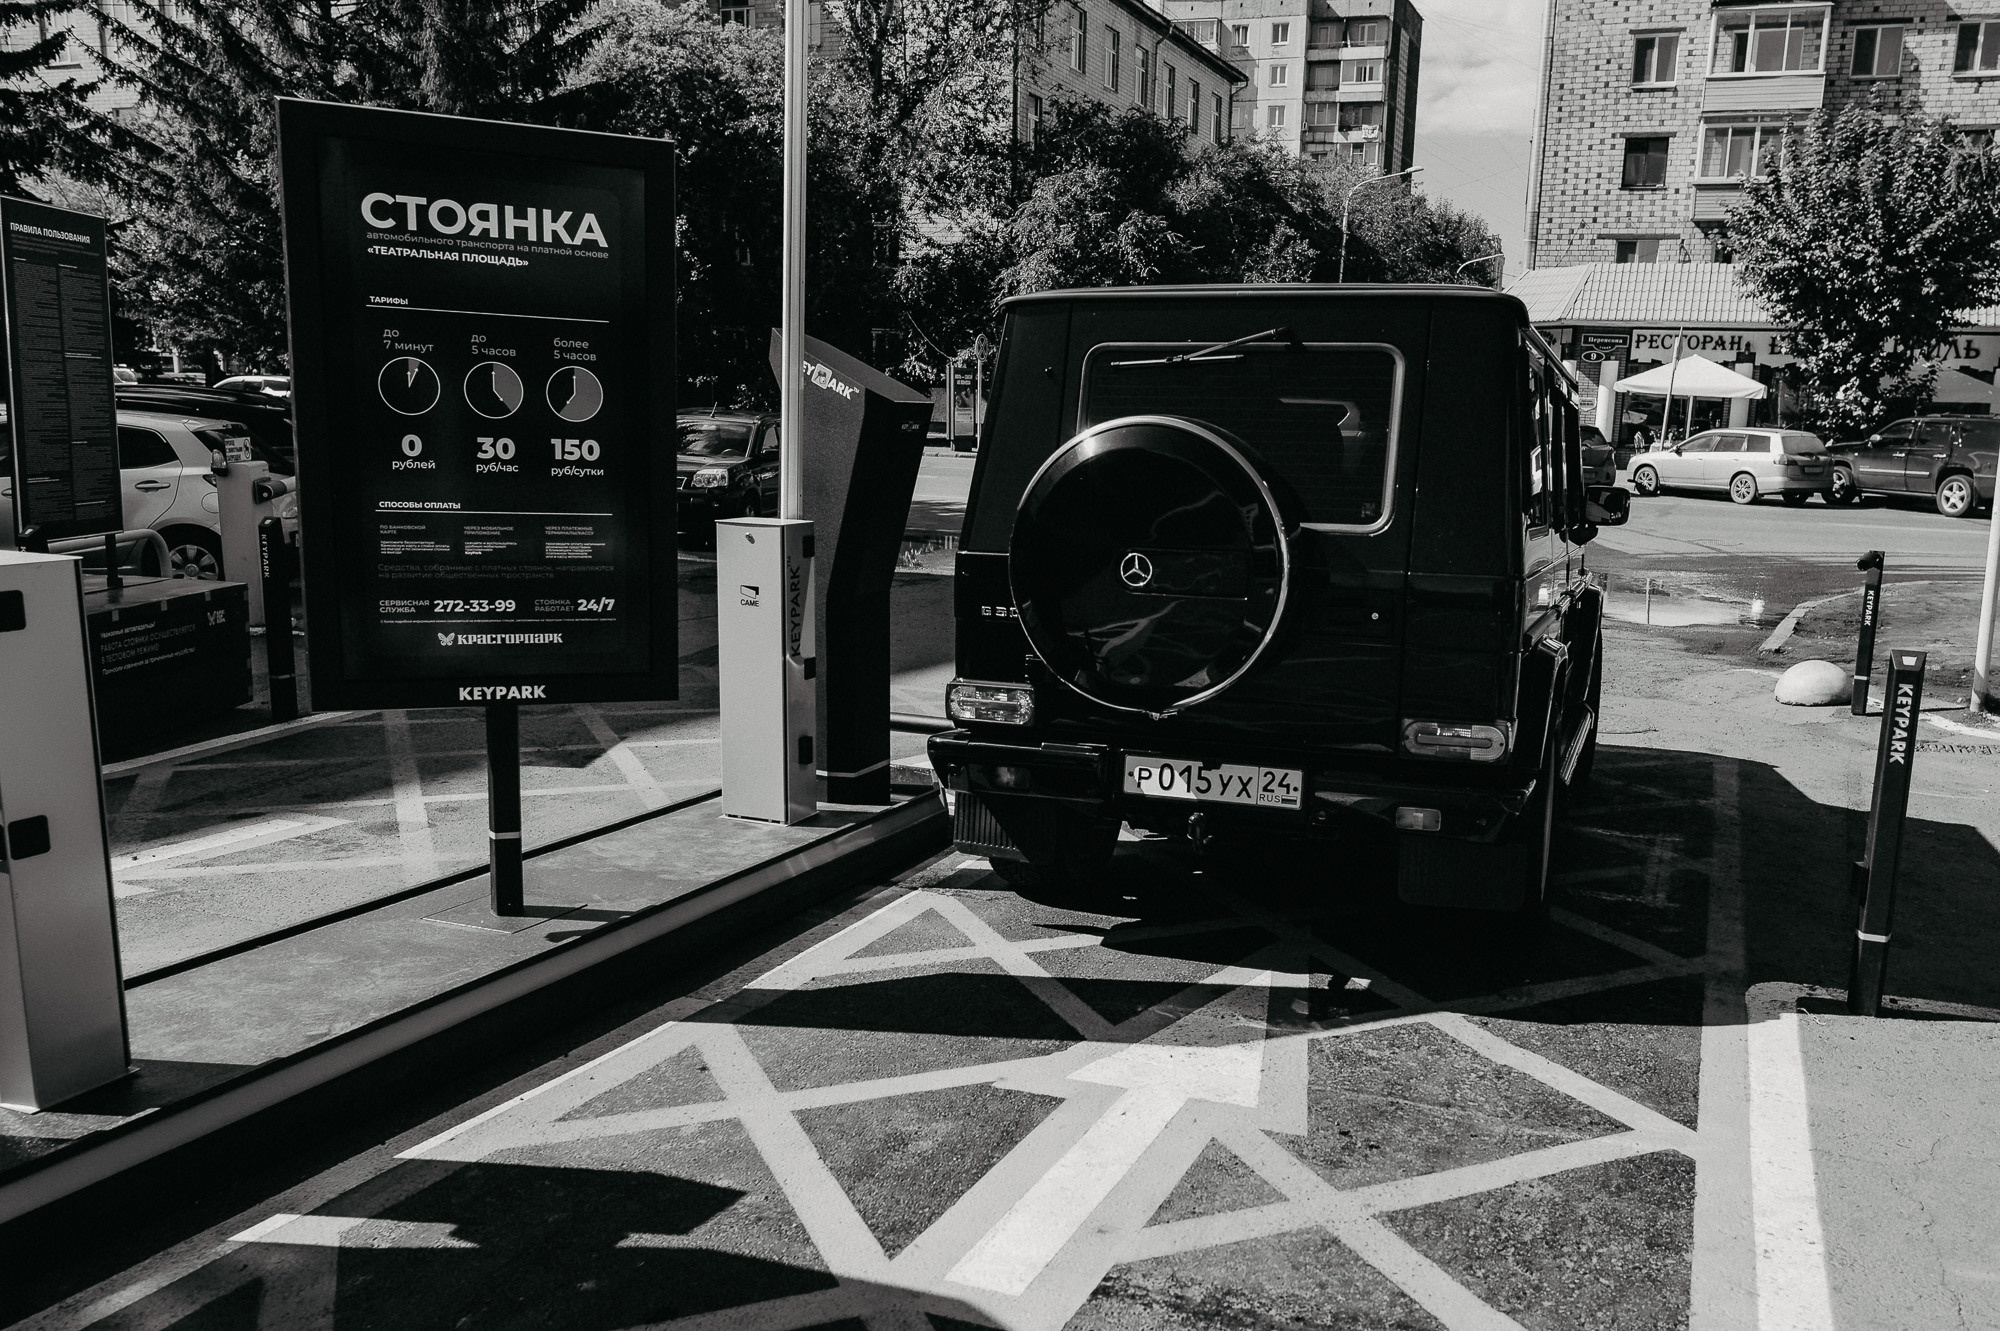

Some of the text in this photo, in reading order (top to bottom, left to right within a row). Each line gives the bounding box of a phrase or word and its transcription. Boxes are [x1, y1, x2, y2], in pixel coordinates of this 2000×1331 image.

[361, 192, 608, 248] СТОЯНКА
[9, 222, 42, 236] ПРАВИЛА
[43, 228, 90, 244] ПОЛЬЗОВАНИЯ
[366, 231, 609, 259] автомобильного транспорта на платной основе
[367, 245, 529, 268] «ТЕАТРАЛЬНАЯ ПЛОЩАДЬ»
[369, 295, 409, 306] ТАРИФЫ
[383, 329, 400, 340] до
[471, 334, 487, 345] до
[383, 340, 434, 353] 7 минут
[553, 337, 590, 349] более
[471, 345, 517, 358] 5 часов
[553, 350, 597, 362] 5 часов
[1590, 352, 1597, 360] 9
[401, 433, 423, 457] 0
[476, 436, 516, 460] 30
[550, 438, 601, 462] 150
[392, 459, 436, 471] рублей
[475, 461, 519, 474] руб/час
[550, 465, 605, 477] руб/сутки
[378, 500, 461, 510] СПОСОБЫ ОПЛАТЫ
[261, 533, 270, 578] KEYPARK
[424, 563, 473, 572] собранные
[433, 599, 516, 613] 272-33-99
[577, 596, 615, 613] 24/7
[740, 598, 760, 608] CAME
[1864, 590, 1875, 626] KEYPARK
[458, 684, 547, 701] KEYPARK
[1889, 683, 1914, 765] KEYPARK
[1262, 770, 1290, 795] 24
[1259, 793, 1281, 803] RUS
